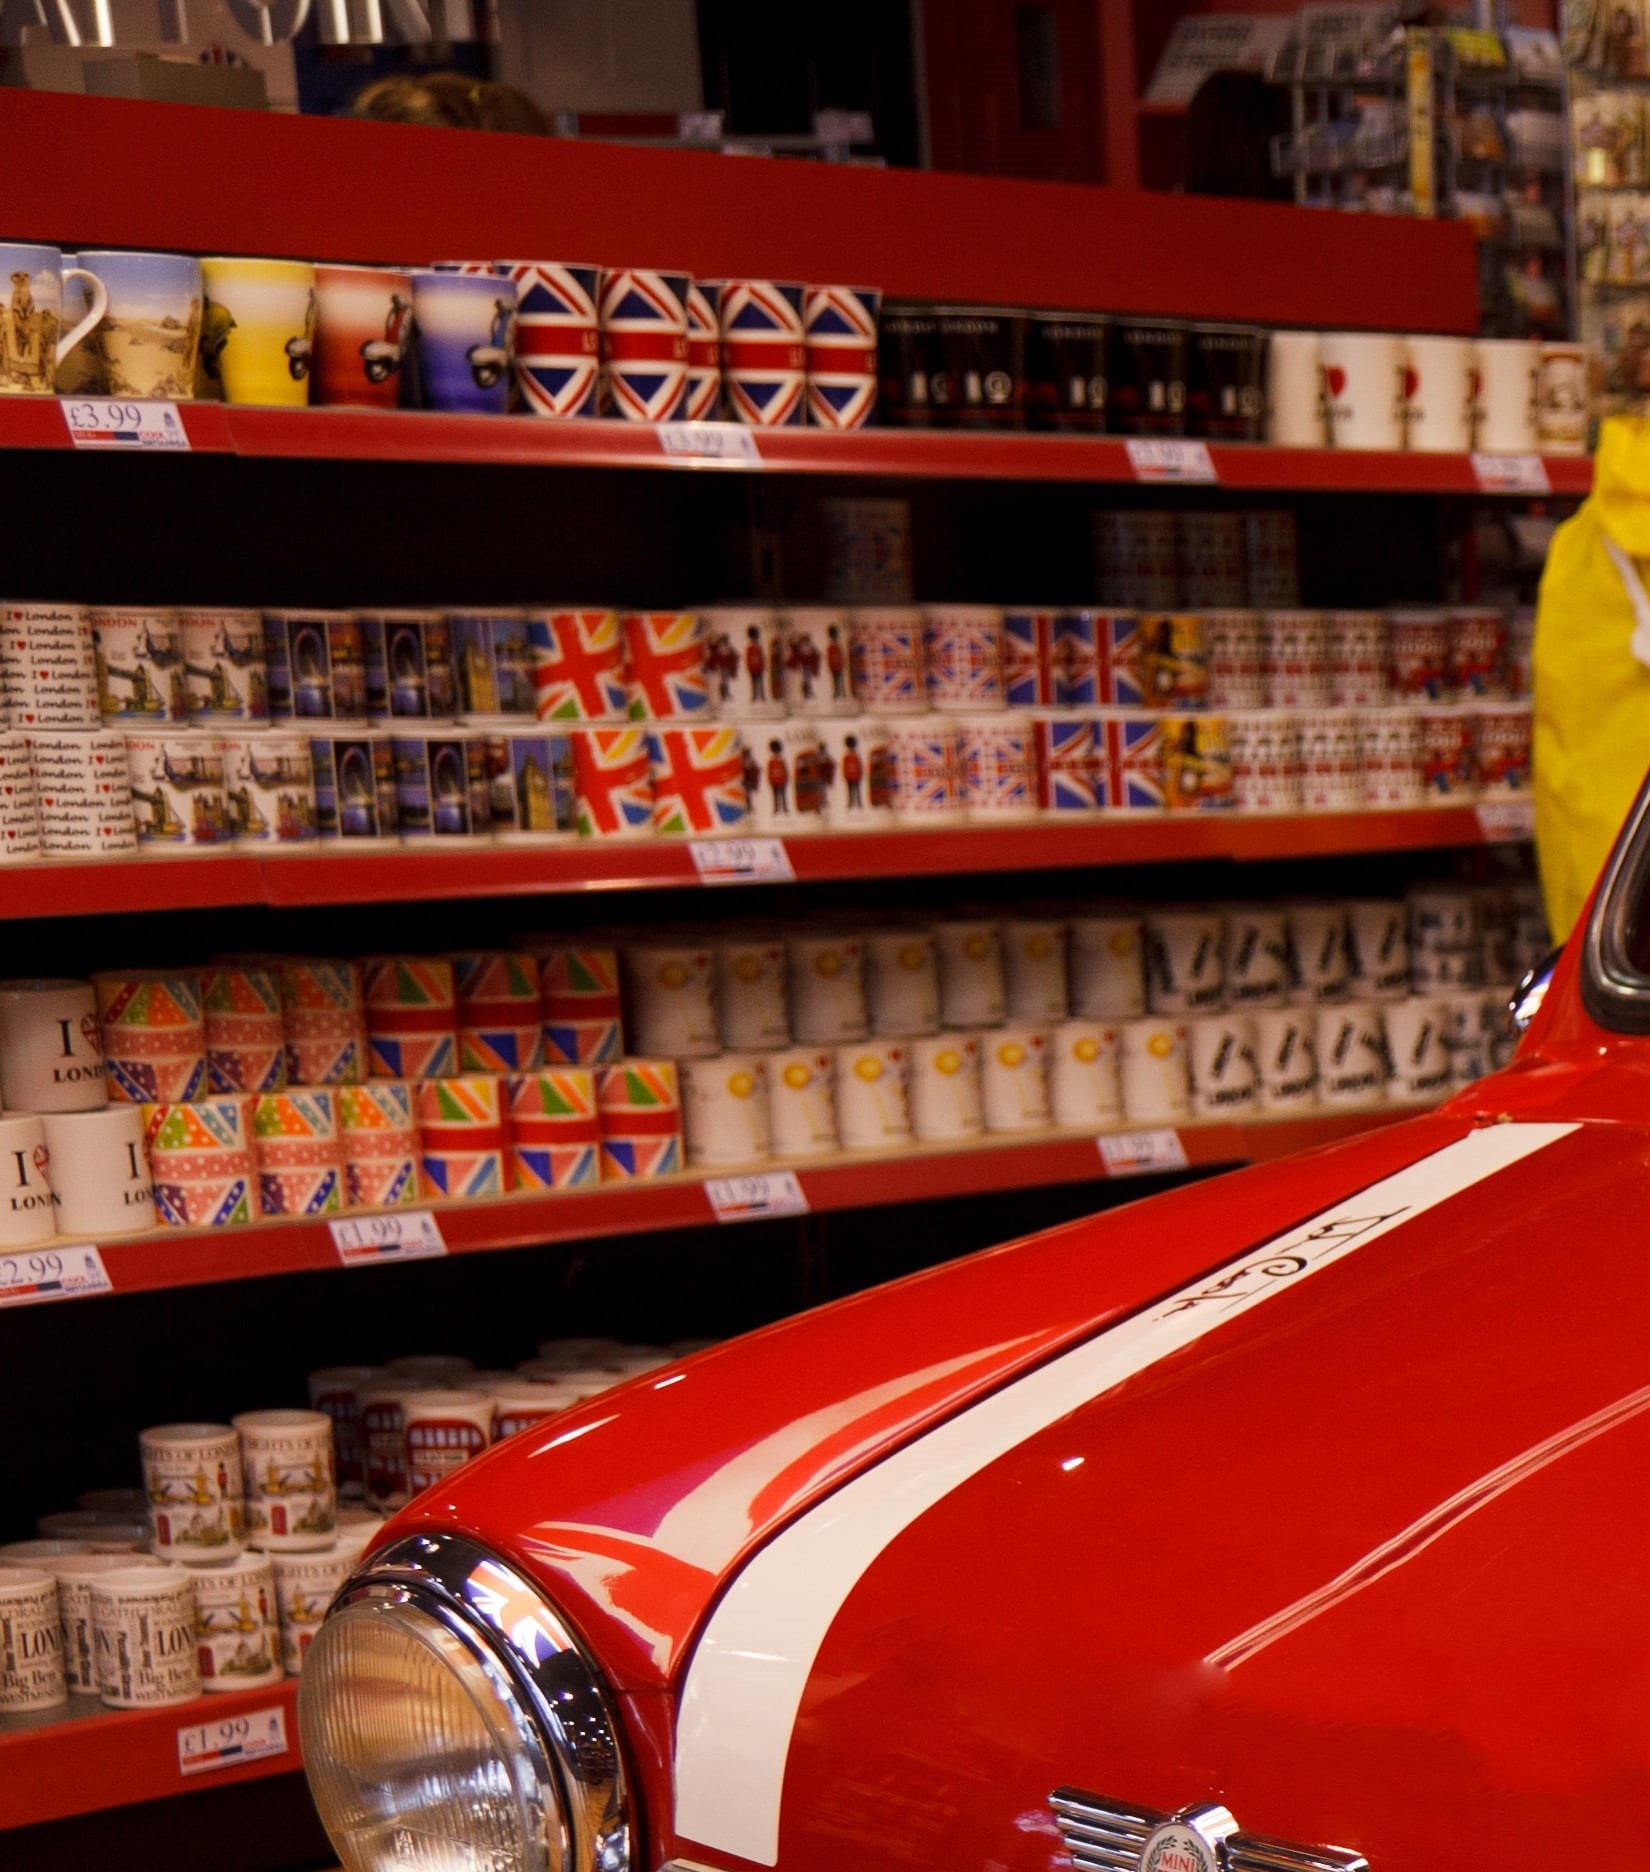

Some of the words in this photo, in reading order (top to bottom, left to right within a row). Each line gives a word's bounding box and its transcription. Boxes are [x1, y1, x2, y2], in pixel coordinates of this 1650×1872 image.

[70, 403, 141, 429] £3.99
[57, 1019, 73, 1057] I
[14, 1151, 30, 1187] I
[126, 1142, 140, 1180] I
[184, 1717, 250, 1753] £1.99
